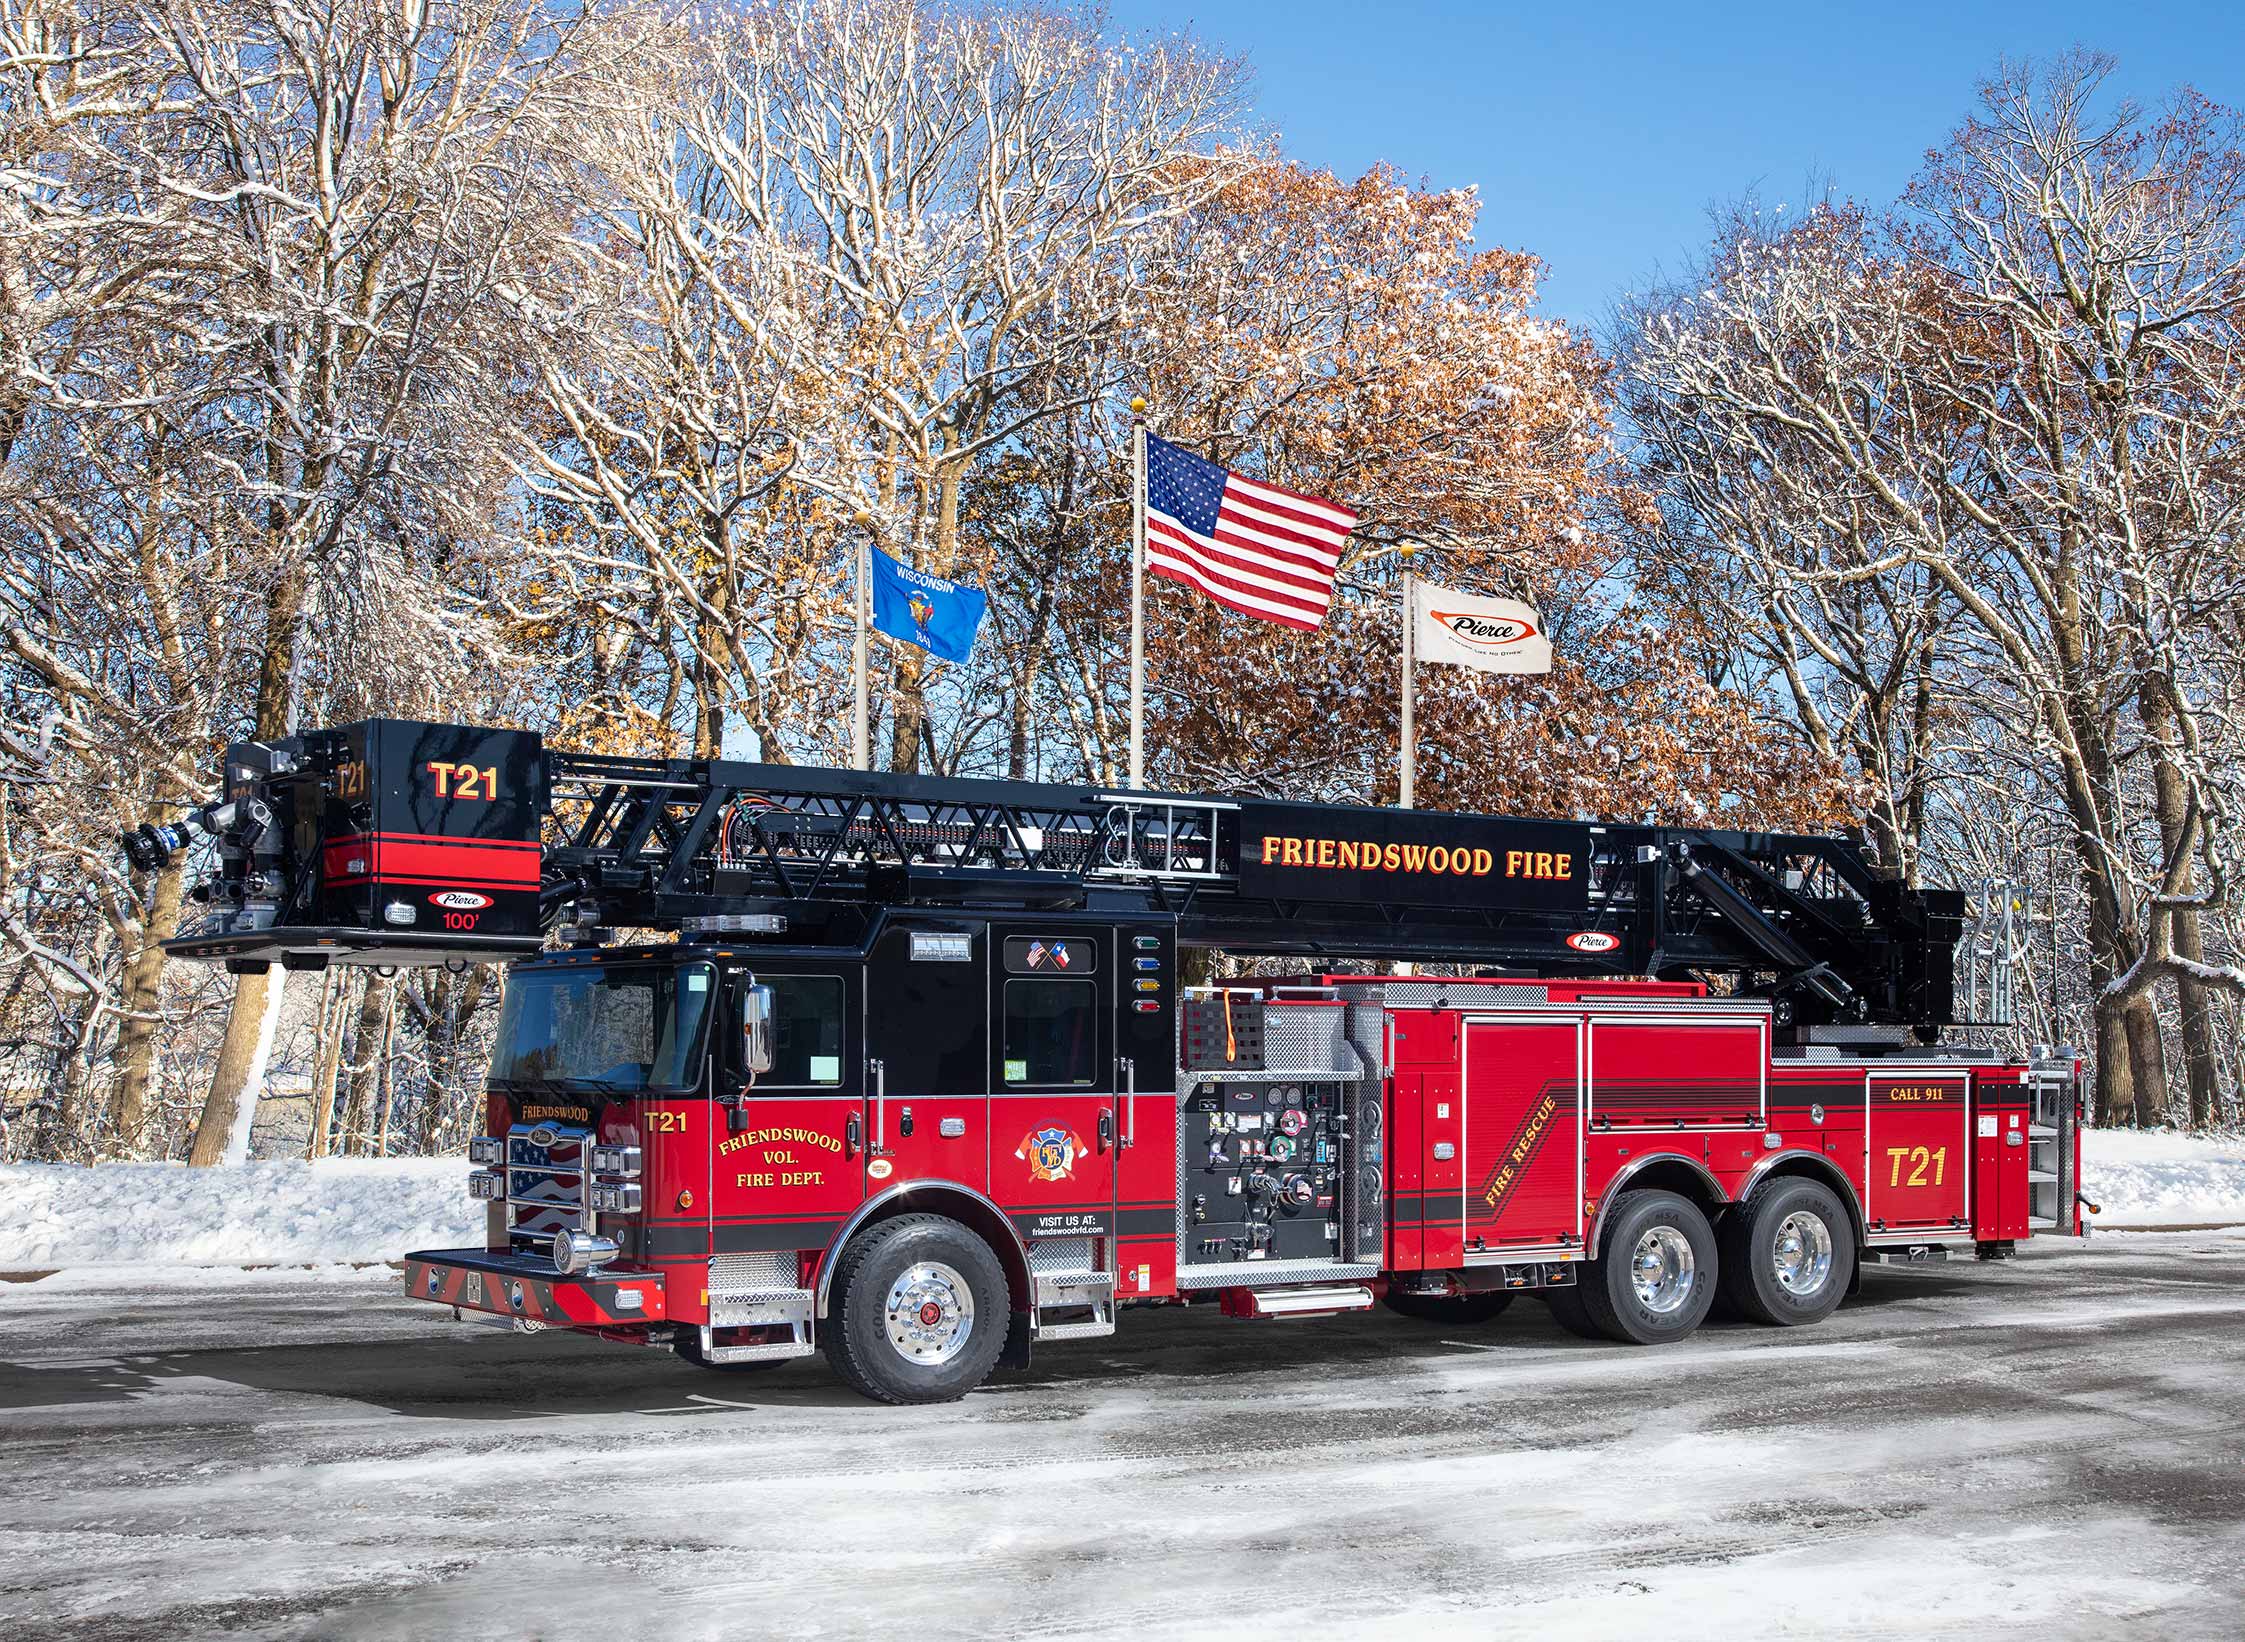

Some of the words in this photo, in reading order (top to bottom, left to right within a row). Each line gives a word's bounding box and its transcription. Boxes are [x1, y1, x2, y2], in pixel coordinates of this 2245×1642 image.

[896, 565, 956, 594] WISCONSIN
[1453, 616, 1515, 638] Pierce
[427, 760, 497, 801] T21
[1261, 836, 1493, 876] FRIENDSWOOD
[1505, 850, 1572, 880] FIRE
[442, 893, 481, 908] Pierce
[1578, 934, 1608, 947] Pierce
[1890, 1088, 1921, 1100] CALL
[1925, 1088, 1943, 1100] 911
[522, 1105, 589, 1122] FRIENDSWOOD
[644, 1111, 687, 1133] T21
[718, 1127, 842, 1156] FRIENDSWOOD
[763, 1151, 800, 1165] VOL.
[1485, 1165, 1514, 1208] FIRE
[1512, 1096, 1556, 1163] RESCUE
[1887, 1146, 1947, 1188] T21
[737, 1173, 774, 1187] FIRE
[781, 1171, 825, 1186] DEPT.
[1032, 1225, 1104, 1236] friendswoodvfd.com
[1039, 1216, 1063, 1227] VISIT
[1065, 1215, 1080, 1226] US
[1082, 1215, 1096, 1225] AT:
